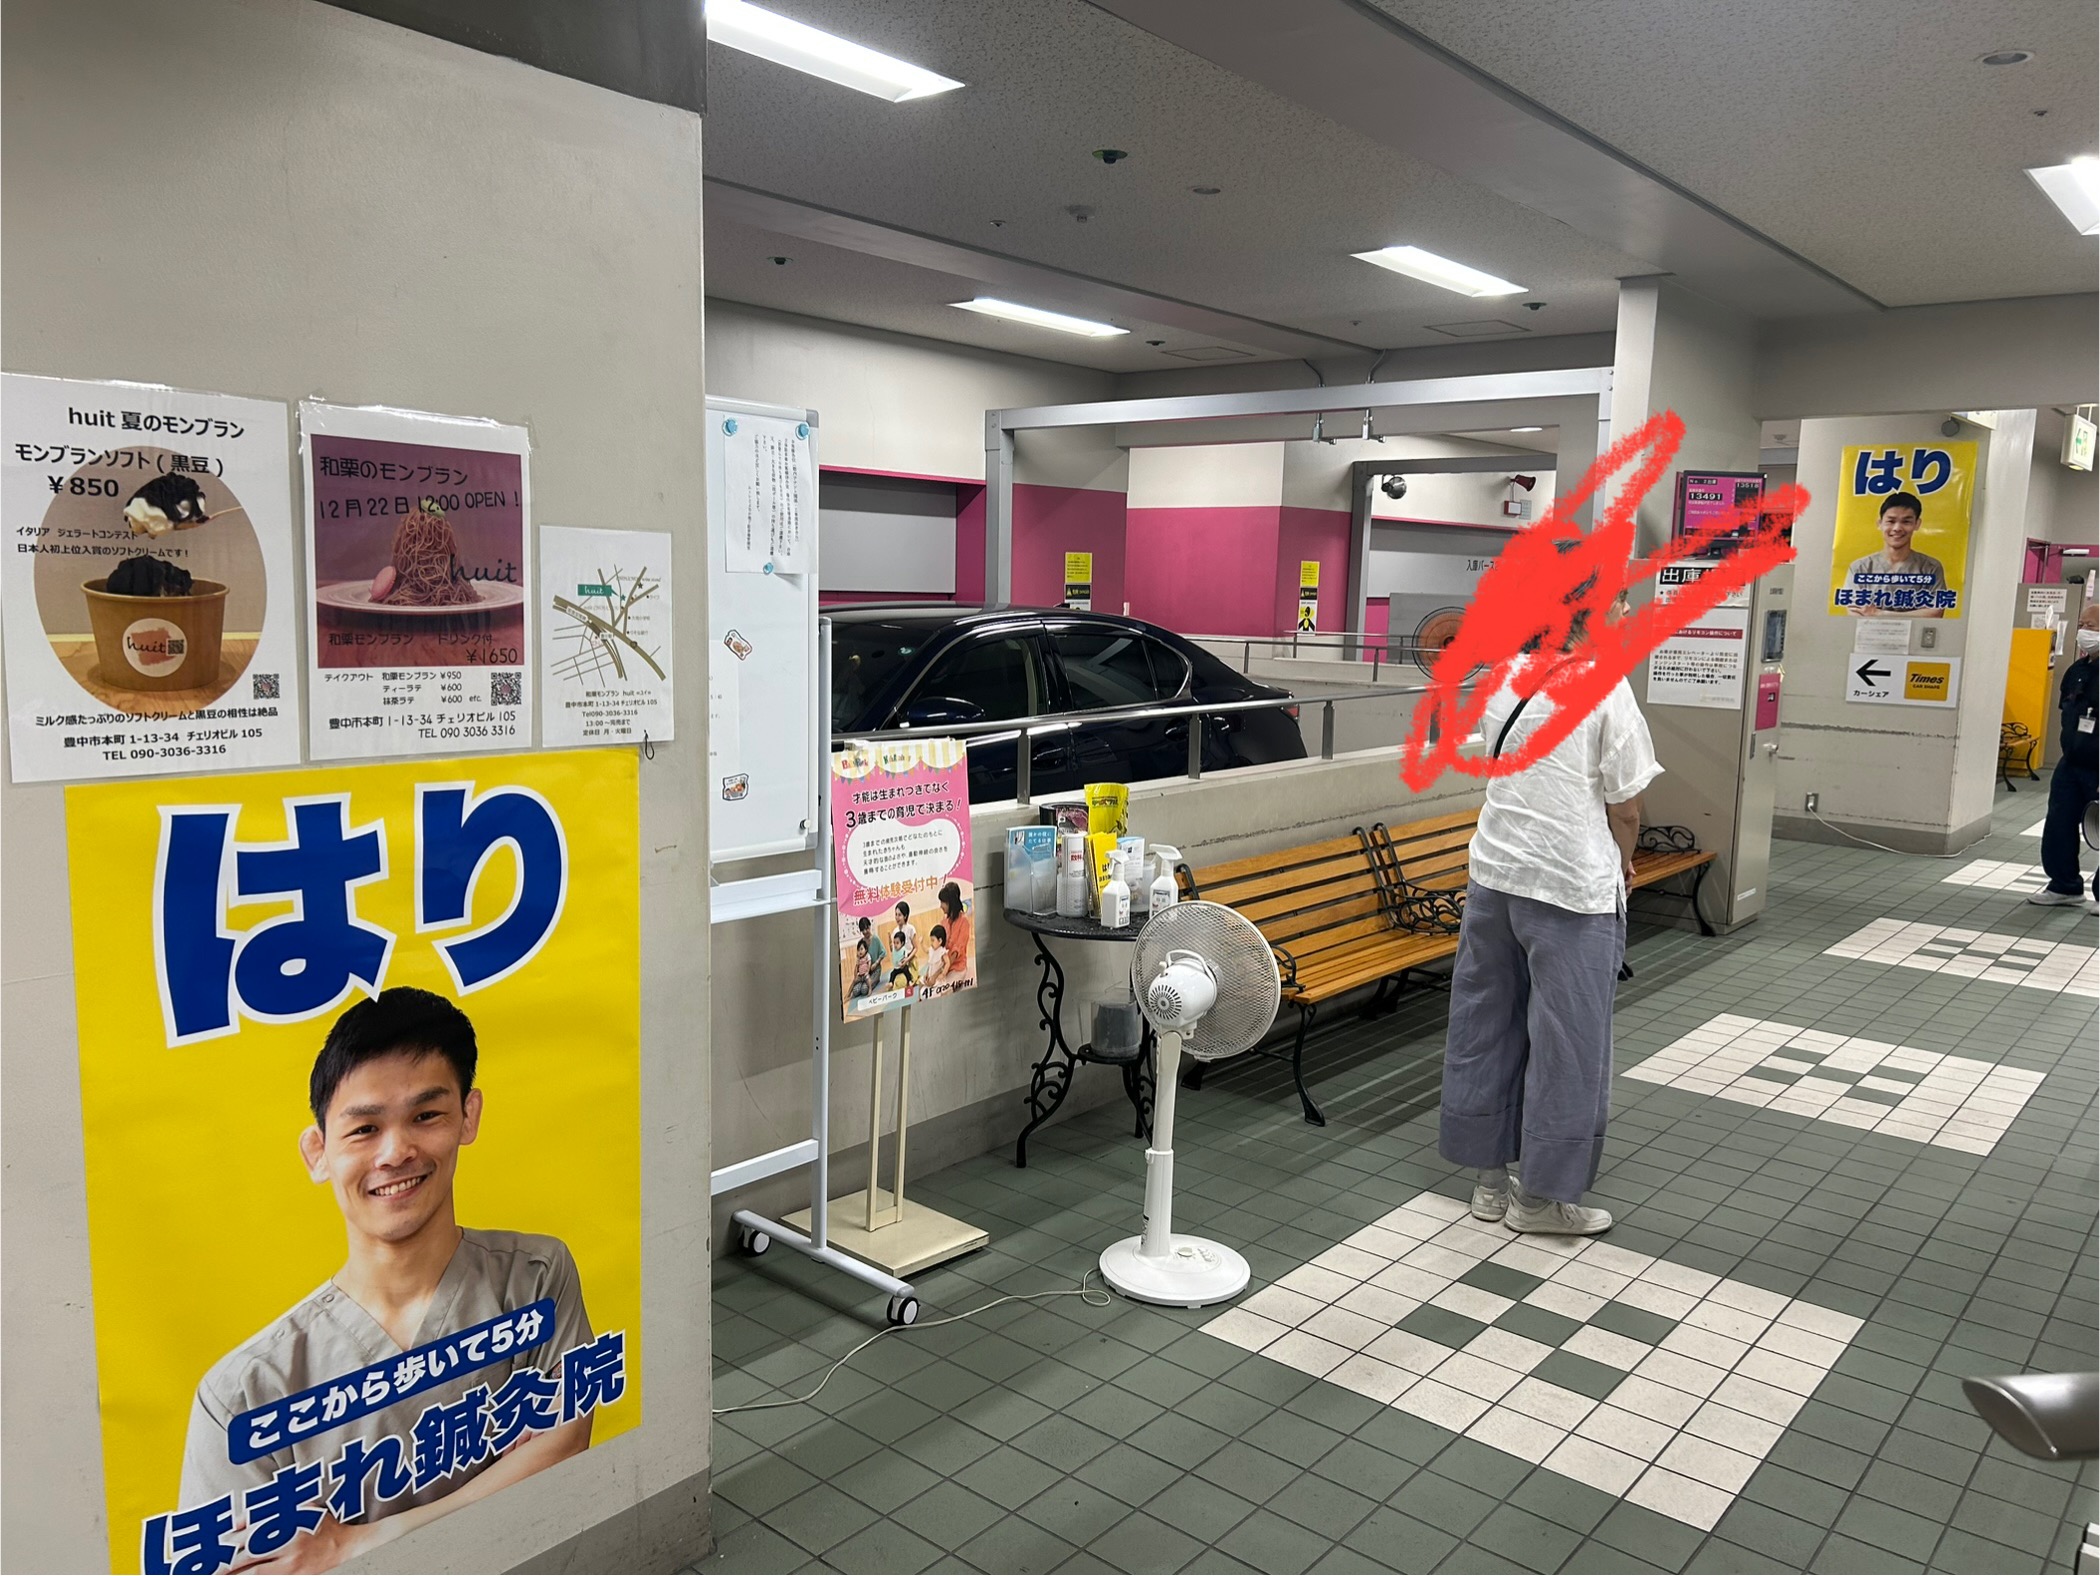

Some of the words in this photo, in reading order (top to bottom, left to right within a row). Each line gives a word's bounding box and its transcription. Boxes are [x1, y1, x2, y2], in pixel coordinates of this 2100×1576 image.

[68, 407, 116, 428] huit
[121, 411, 245, 439] 夏のモンブラン
[319, 456, 468, 486] 和栗のモンブラン
[1854, 449, 1952, 496] はり
[48, 476, 119, 497] ¥850
[16, 526, 50, 537] イタリア
[449, 553, 517, 583] huit
[1662, 568, 1703, 584] 出庫
[1857, 574, 1933, 584] ここから歩いて5分
[1834, 588, 1957, 609] ほまれ鍼灸院
[127, 636, 167, 657] huit
[328, 632, 414, 647] 和栗モンブラン
[437, 633, 493, 646] ドリンク付
[466, 648, 518, 664] ¥1650
[440, 683, 462, 692] ¥600
[1909, 673, 1945, 685] Times
[440, 695, 463, 704] ¥600
[1853, 689, 1889, 699] カーシェア
[329, 716, 384, 730] 豊中市本町
[388, 714, 433, 727] 1-13-34
[436, 711, 495, 725] チェリオビル
[498, 711, 516, 723] 105
[63, 733, 126, 747] 豊中市本町
[129, 732, 179, 744] 1-13-34
[186, 729, 238, 742] チェリオビル
[241, 728, 262, 738] 105
[418, 728, 437, 739] TEL
[440, 727, 460, 739] 090
[463, 726, 488, 737] 3036
[490, 725, 515, 736] 3316
[103, 749, 127, 761] TEL
[130, 744, 226, 760] 090-3036-3316
[853, 781, 949, 804] 才能は生まれつきでなく
[846, 799, 961, 828] 3歳までの育児で決まる!
[153, 780, 567, 1049] はり
[248, 1310, 545, 1449] ここから歩いて5分
[140, 1329, 627, 1576] ほまれ鍼灸院
